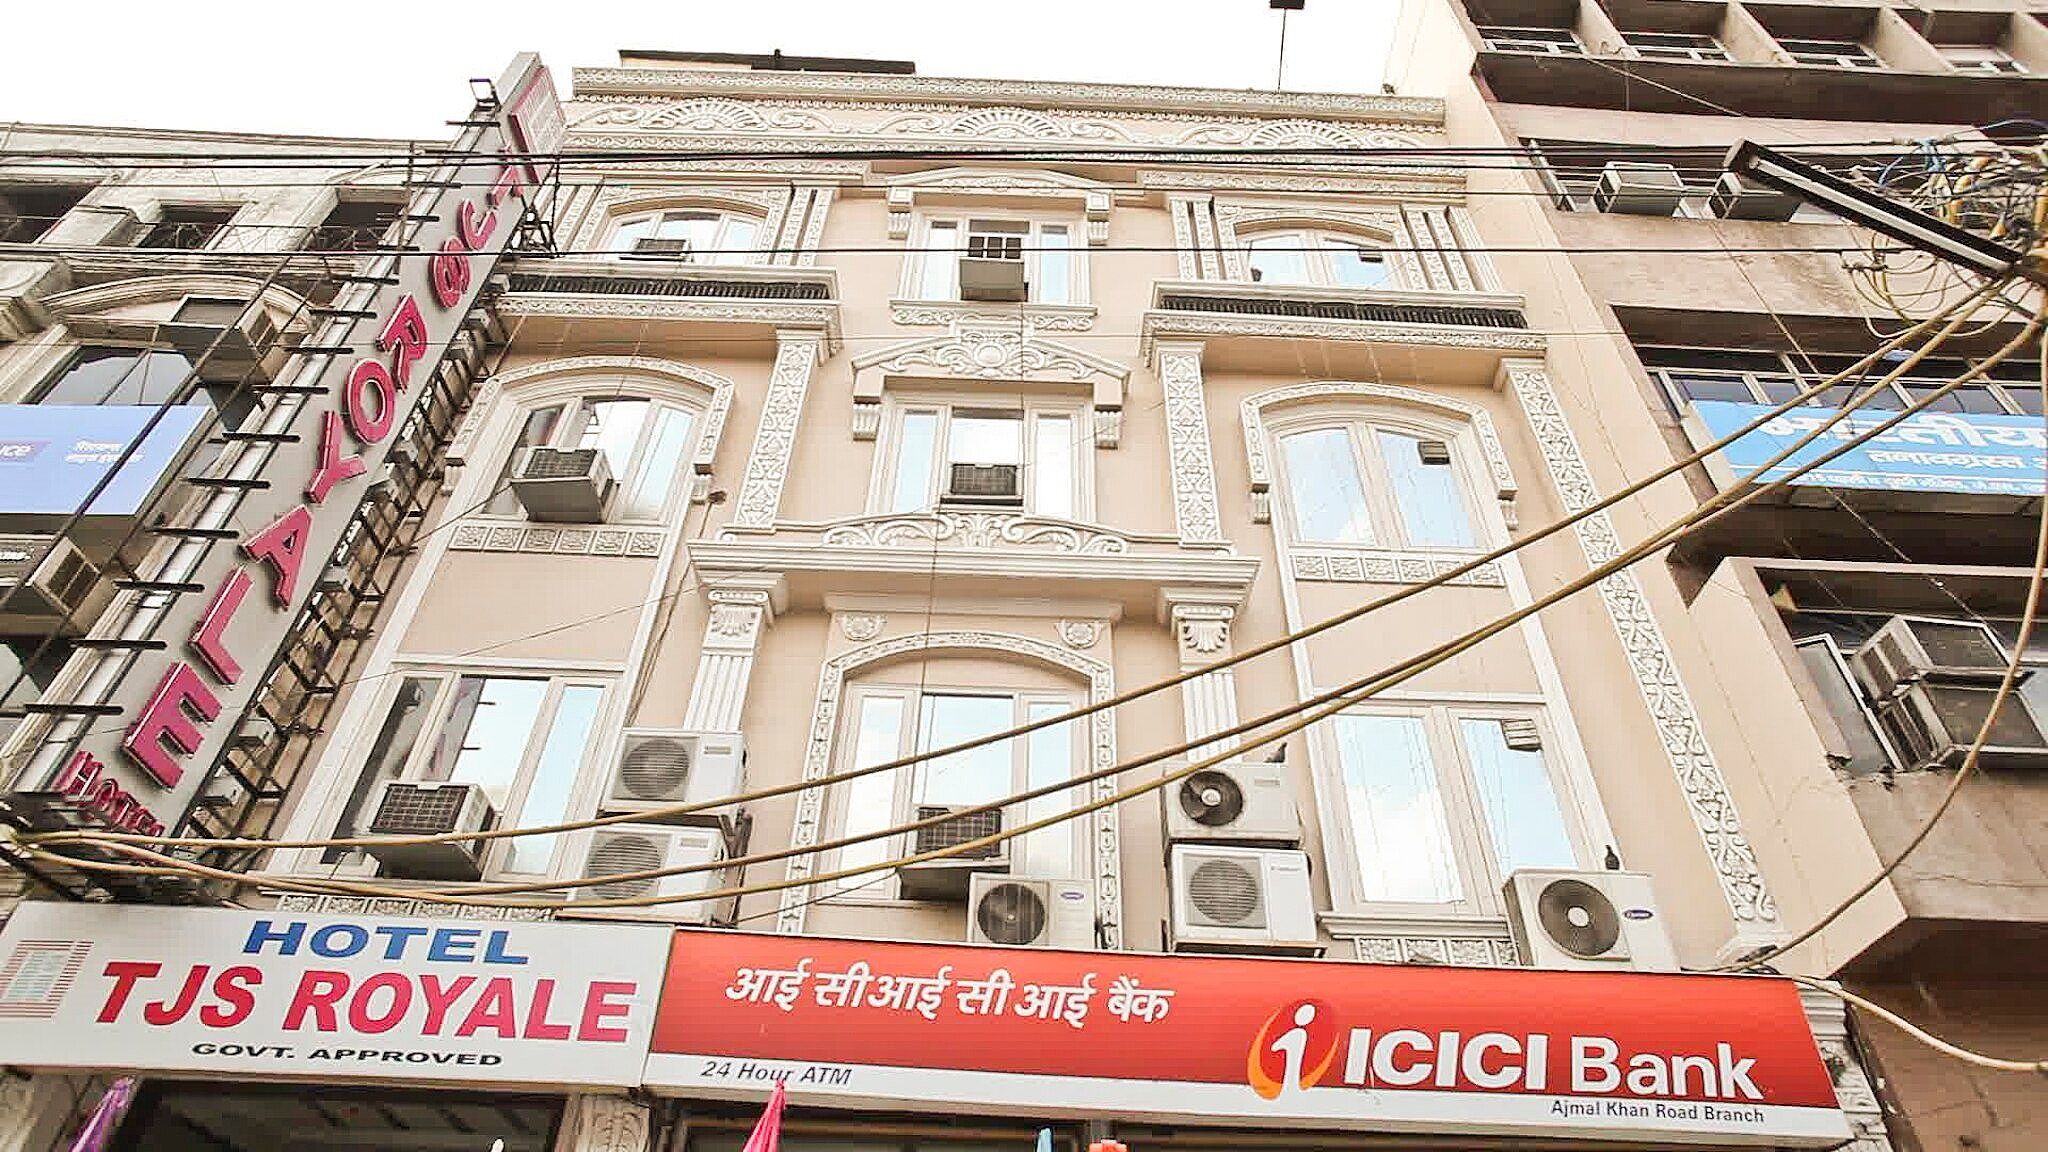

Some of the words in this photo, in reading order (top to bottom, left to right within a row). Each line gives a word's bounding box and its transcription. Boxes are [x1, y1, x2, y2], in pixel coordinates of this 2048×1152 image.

[242, 921, 528, 965] HOTEL
[96, 961, 263, 1027] TJS
[282, 970, 637, 1043] ROYALE
[1107, 975, 1175, 1022] बैंक
[192, 1042, 294, 1060] GOVT.
[307, 1048, 502, 1066] APPROVED
[701, 1060, 732, 1078] 24
[737, 1063, 794, 1081] Hour
[799, 1066, 853, 1085] ATM
[1344, 1028, 1549, 1091] ICICI
[1570, 1036, 1766, 1101] Bank
[1551, 1100, 1601, 1118] Ajmal
[1606, 1102, 1650, 1117] Khan
[1656, 1103, 1698, 1119] Road
[1704, 1106, 1765, 1122] Branch
